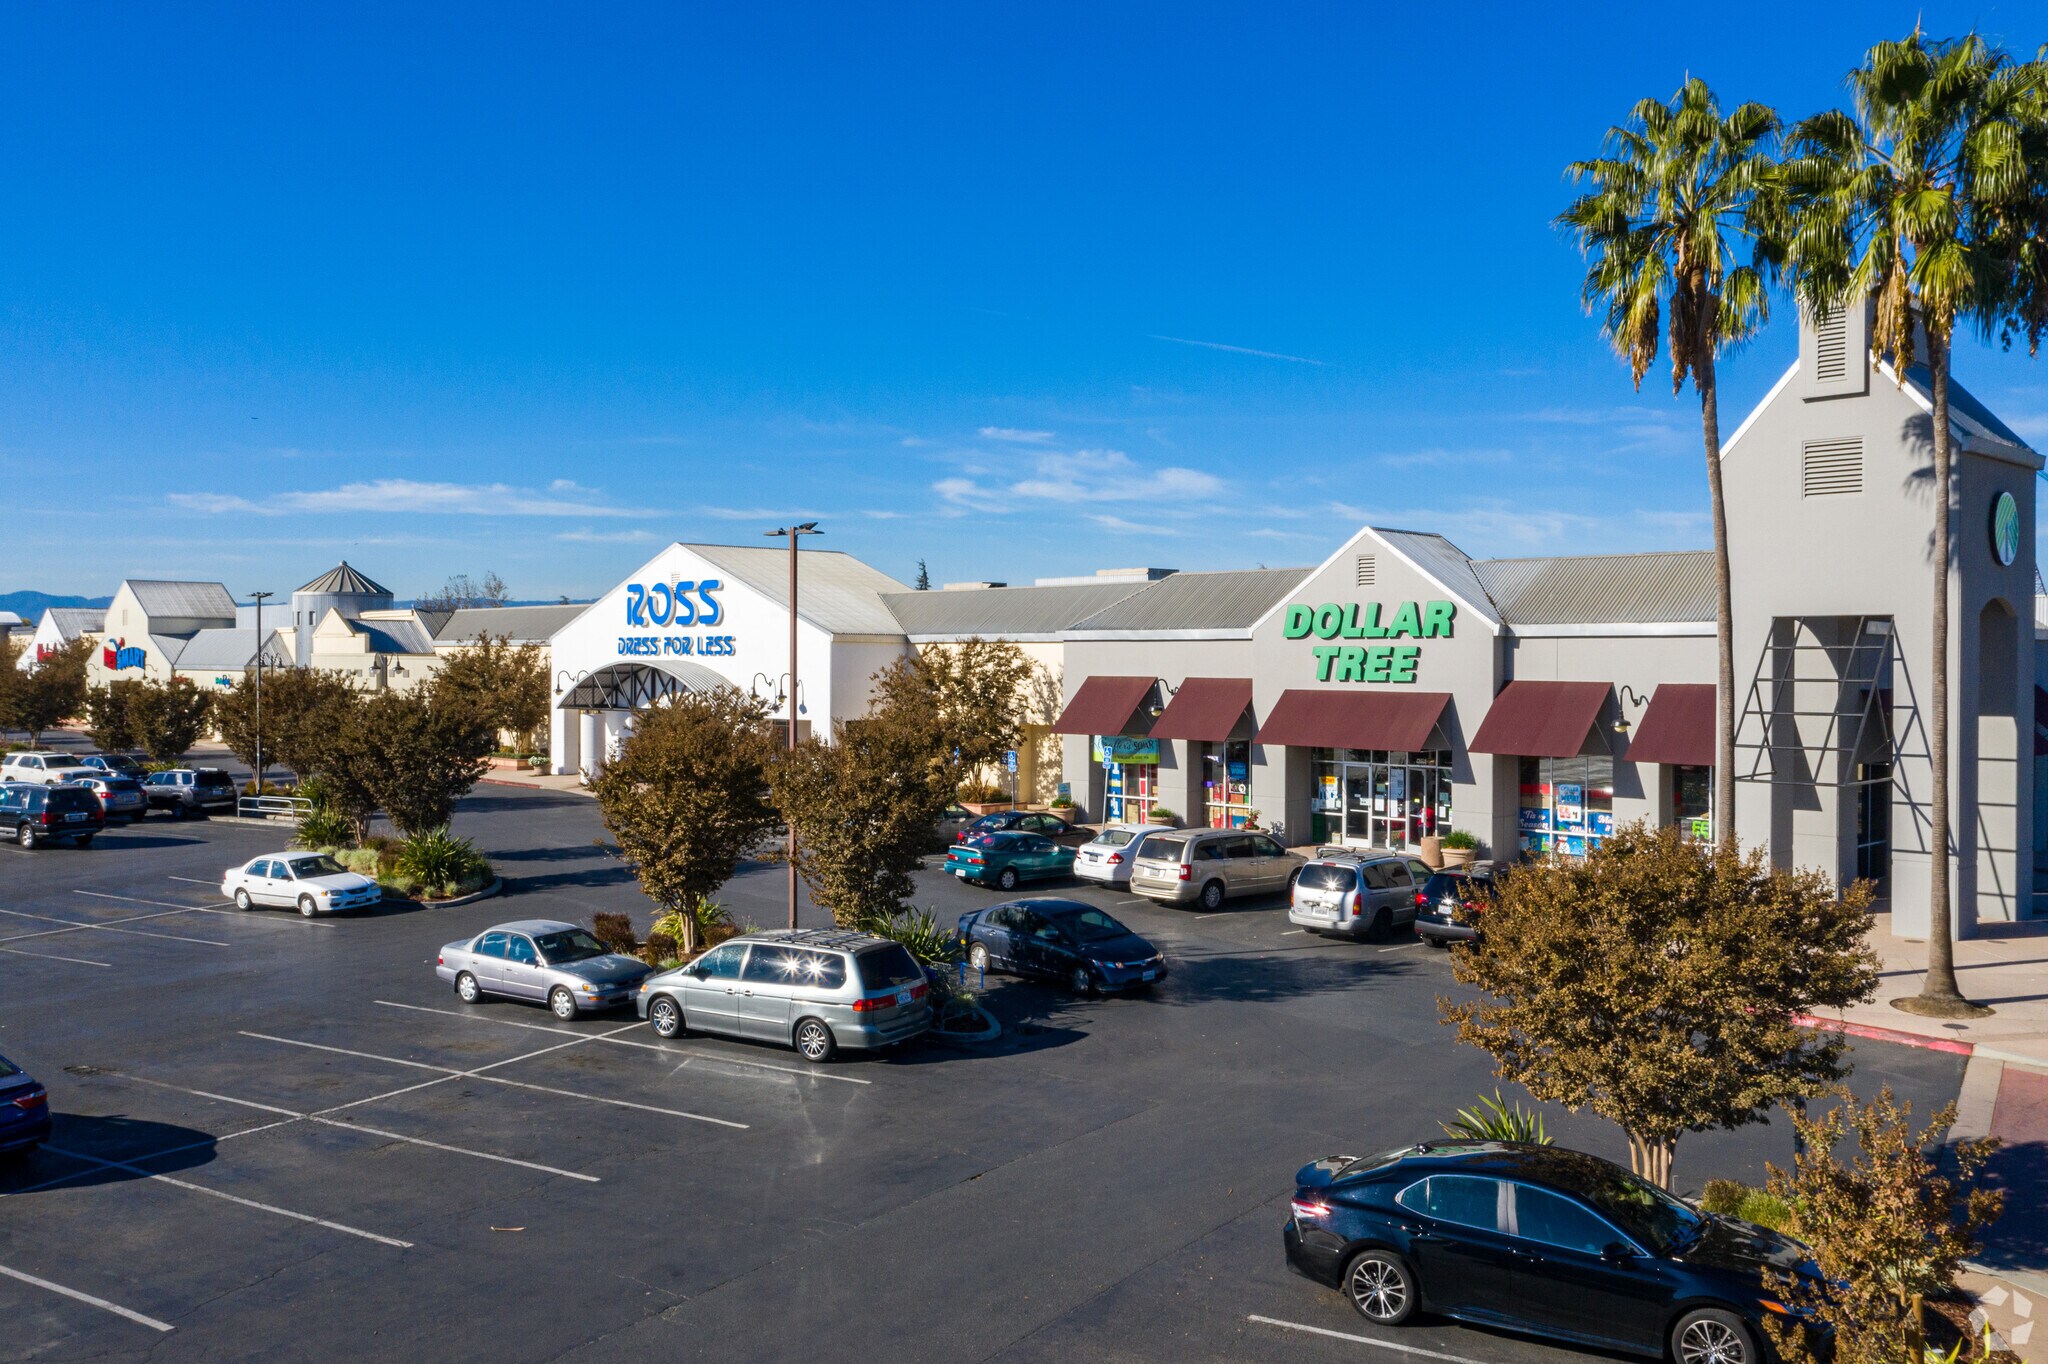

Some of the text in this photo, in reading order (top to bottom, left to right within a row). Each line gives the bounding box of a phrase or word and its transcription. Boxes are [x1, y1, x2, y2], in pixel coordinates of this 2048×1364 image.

[627, 579, 722, 626] ROSS
[1282, 601, 1456, 640] DOLLAR
[618, 635, 735, 655] DRESS FOR LESS
[1312, 646, 1420, 683] TREE
